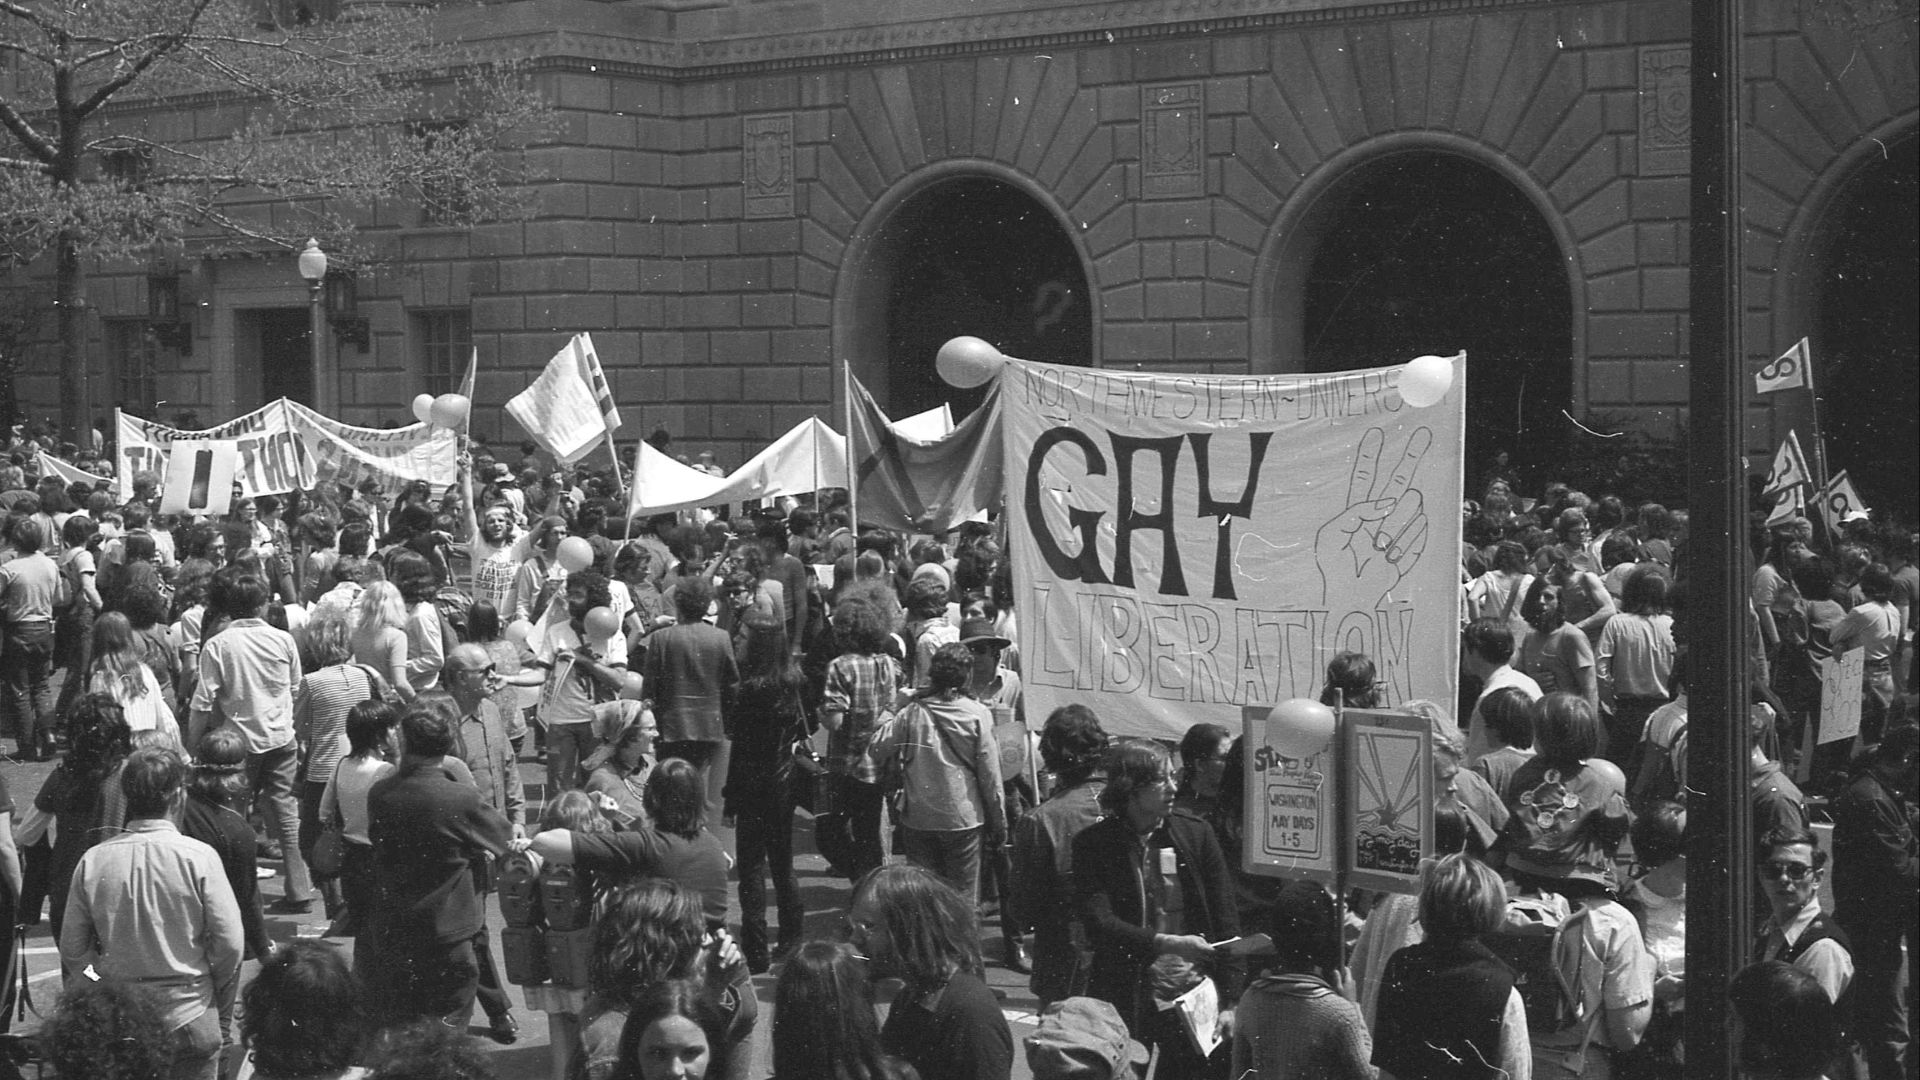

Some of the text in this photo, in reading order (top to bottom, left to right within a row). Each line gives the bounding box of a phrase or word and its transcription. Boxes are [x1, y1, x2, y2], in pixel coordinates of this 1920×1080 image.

[1024, 425, 1274, 600] GAY
[1271, 815, 1315, 830] MAY DAYS
[1281, 832, 1301, 847] 1-5
